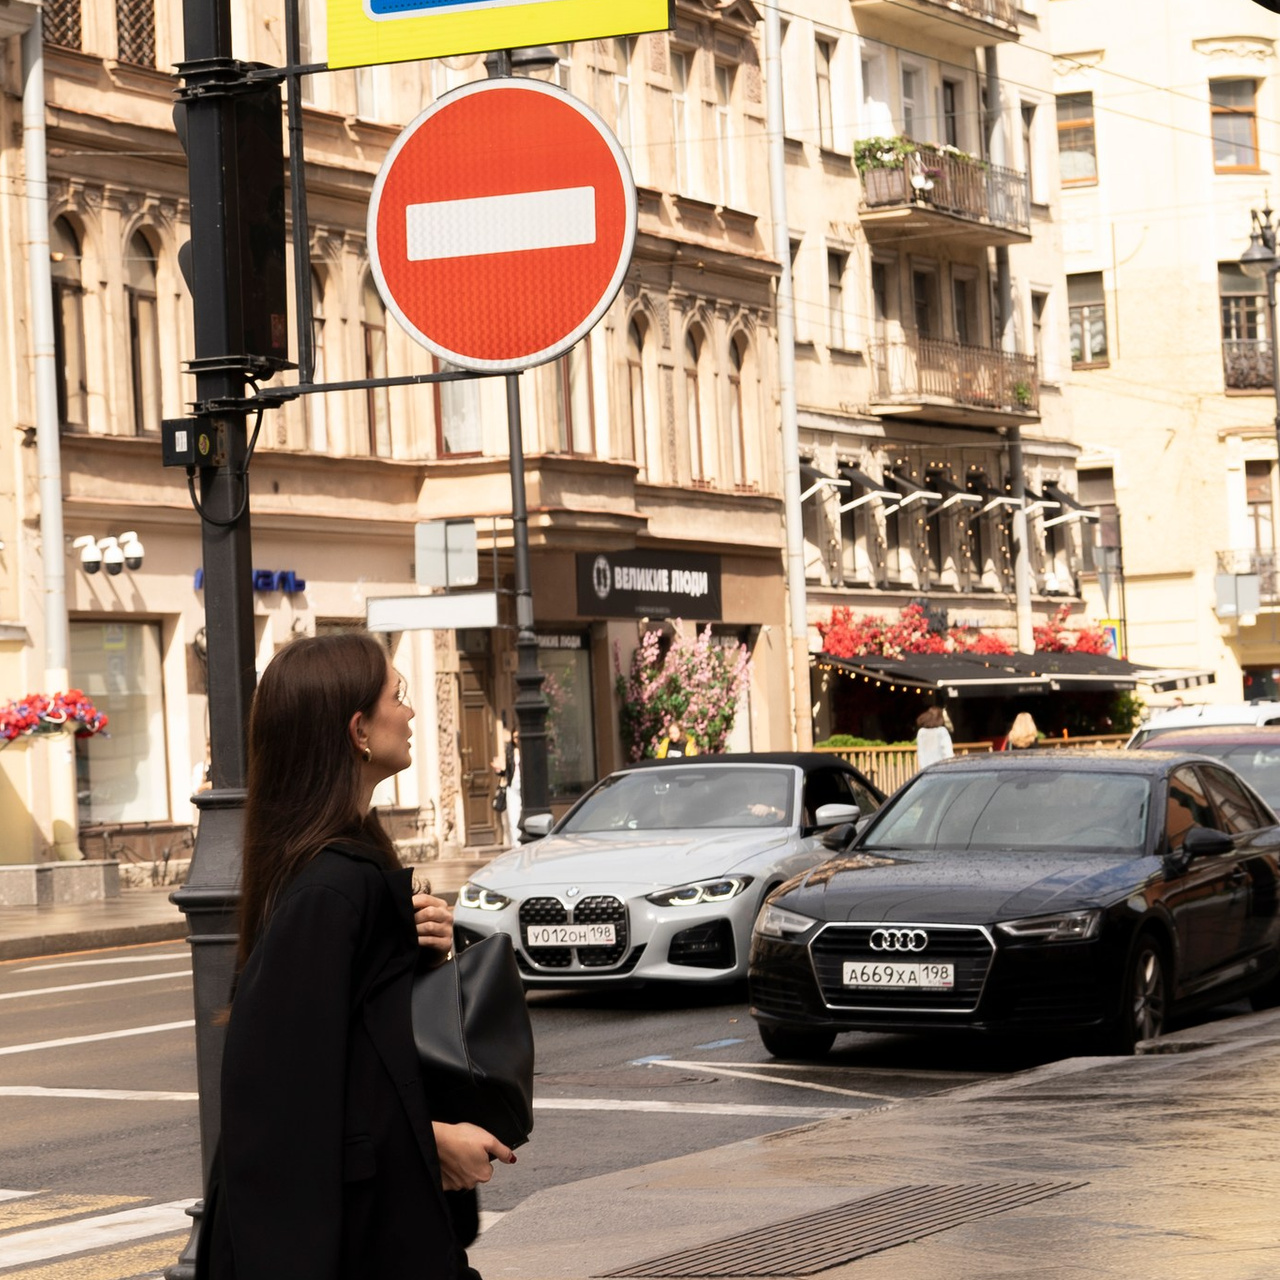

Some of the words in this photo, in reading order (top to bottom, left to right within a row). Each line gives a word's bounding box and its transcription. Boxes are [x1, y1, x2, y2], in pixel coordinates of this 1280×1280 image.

[614, 566, 669, 593] ВЕЛИКИЕ
[671, 569, 708, 597] ЛЮДИ
[533, 928, 586, 942] У012ОН
[589, 926, 611, 938] 198
[849, 965, 918, 984] А669ХА
[922, 965, 950, 980] 198
